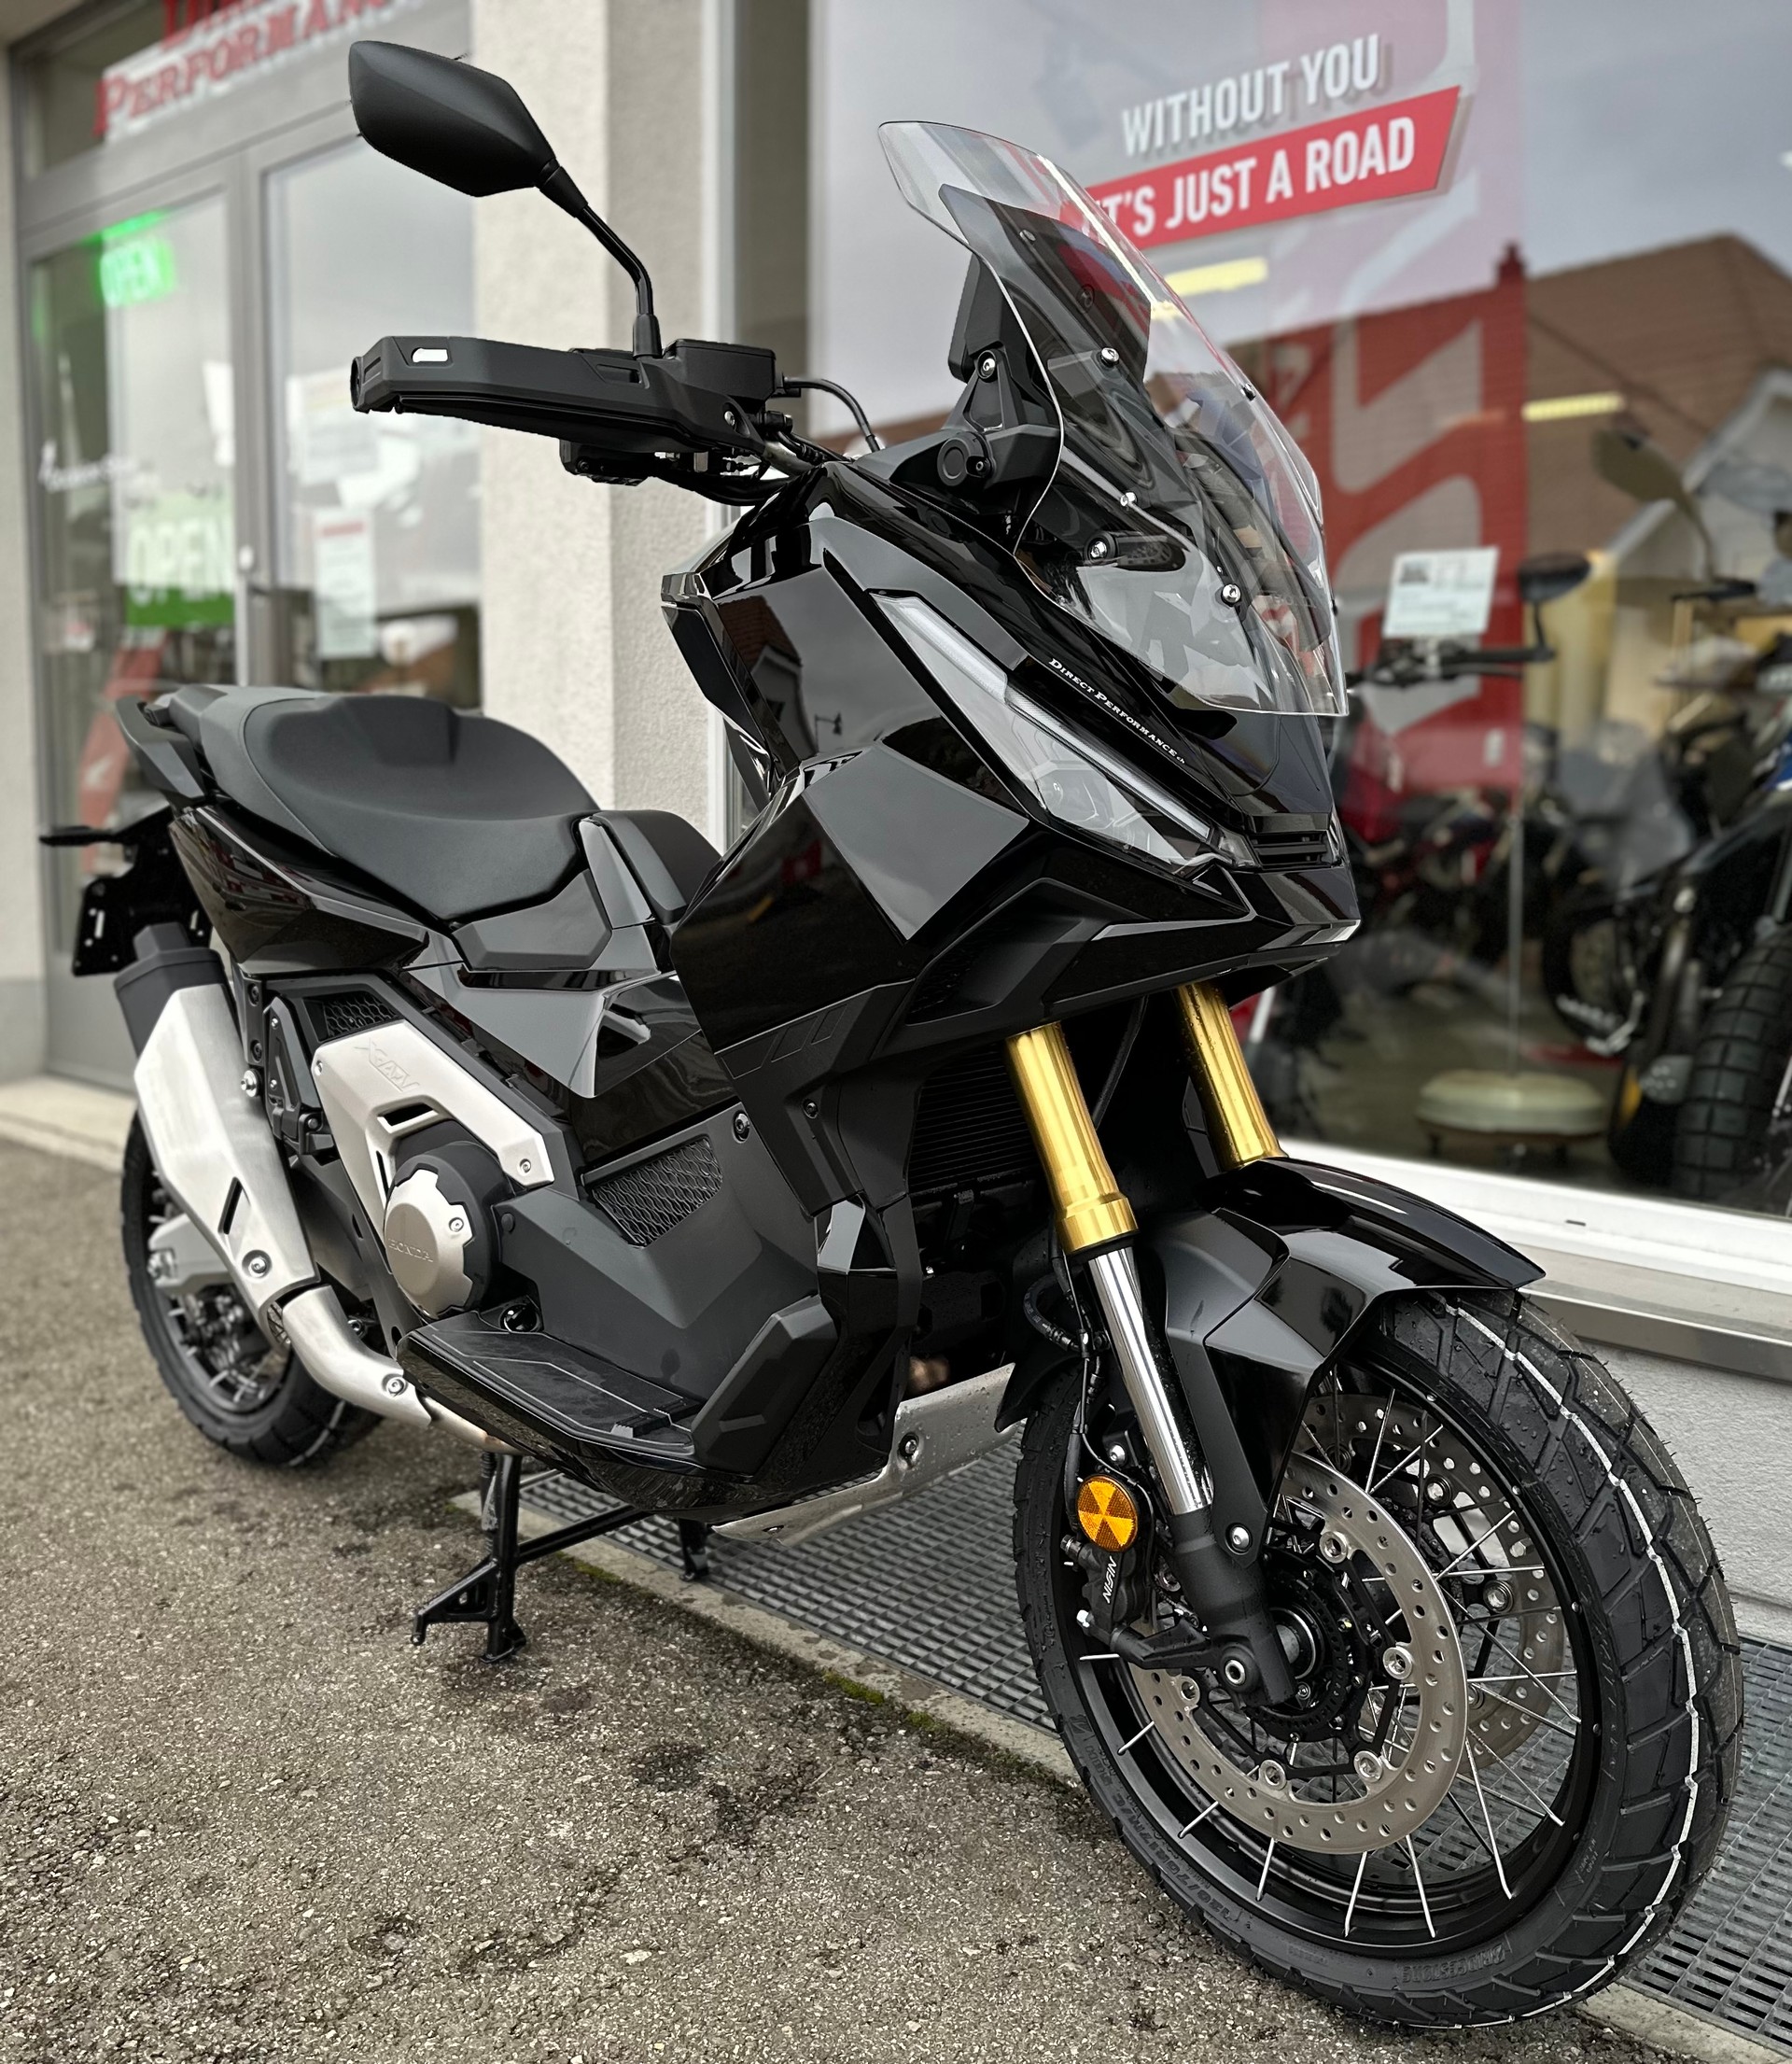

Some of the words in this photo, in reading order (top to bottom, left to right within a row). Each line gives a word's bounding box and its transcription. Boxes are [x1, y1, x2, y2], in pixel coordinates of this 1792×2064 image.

[93, 0, 392, 137] PERFORMAN
[1122, 62, 1290, 157] WITHOUT
[1301, 34, 1380, 105] YOU
[1166, 157, 1257, 230] JUST
[1267, 149, 1294, 204] A
[1307, 117, 1416, 193] ROAD
[1048, 658, 1096, 693] DIRECT
[1094, 691, 1178, 757] PERFORMANCE
[387, 1239, 434, 1263] HONDA
